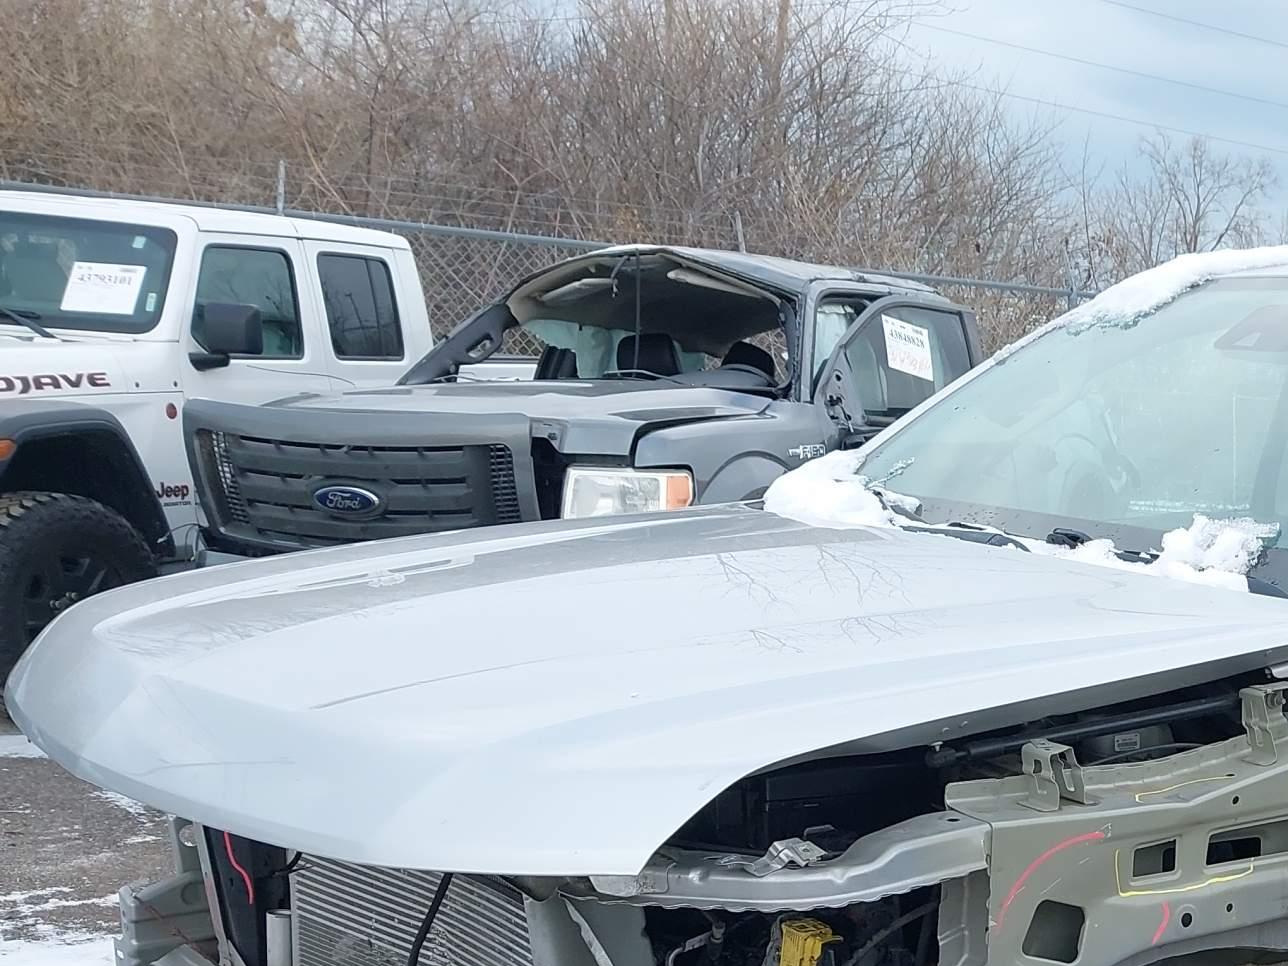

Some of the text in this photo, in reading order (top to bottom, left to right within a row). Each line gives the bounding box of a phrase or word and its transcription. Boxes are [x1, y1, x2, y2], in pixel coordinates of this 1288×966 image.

[0, 372, 111, 395] OJAVE
[156, 481, 190, 500] Jeep
[326, 491, 361, 509] Ford
